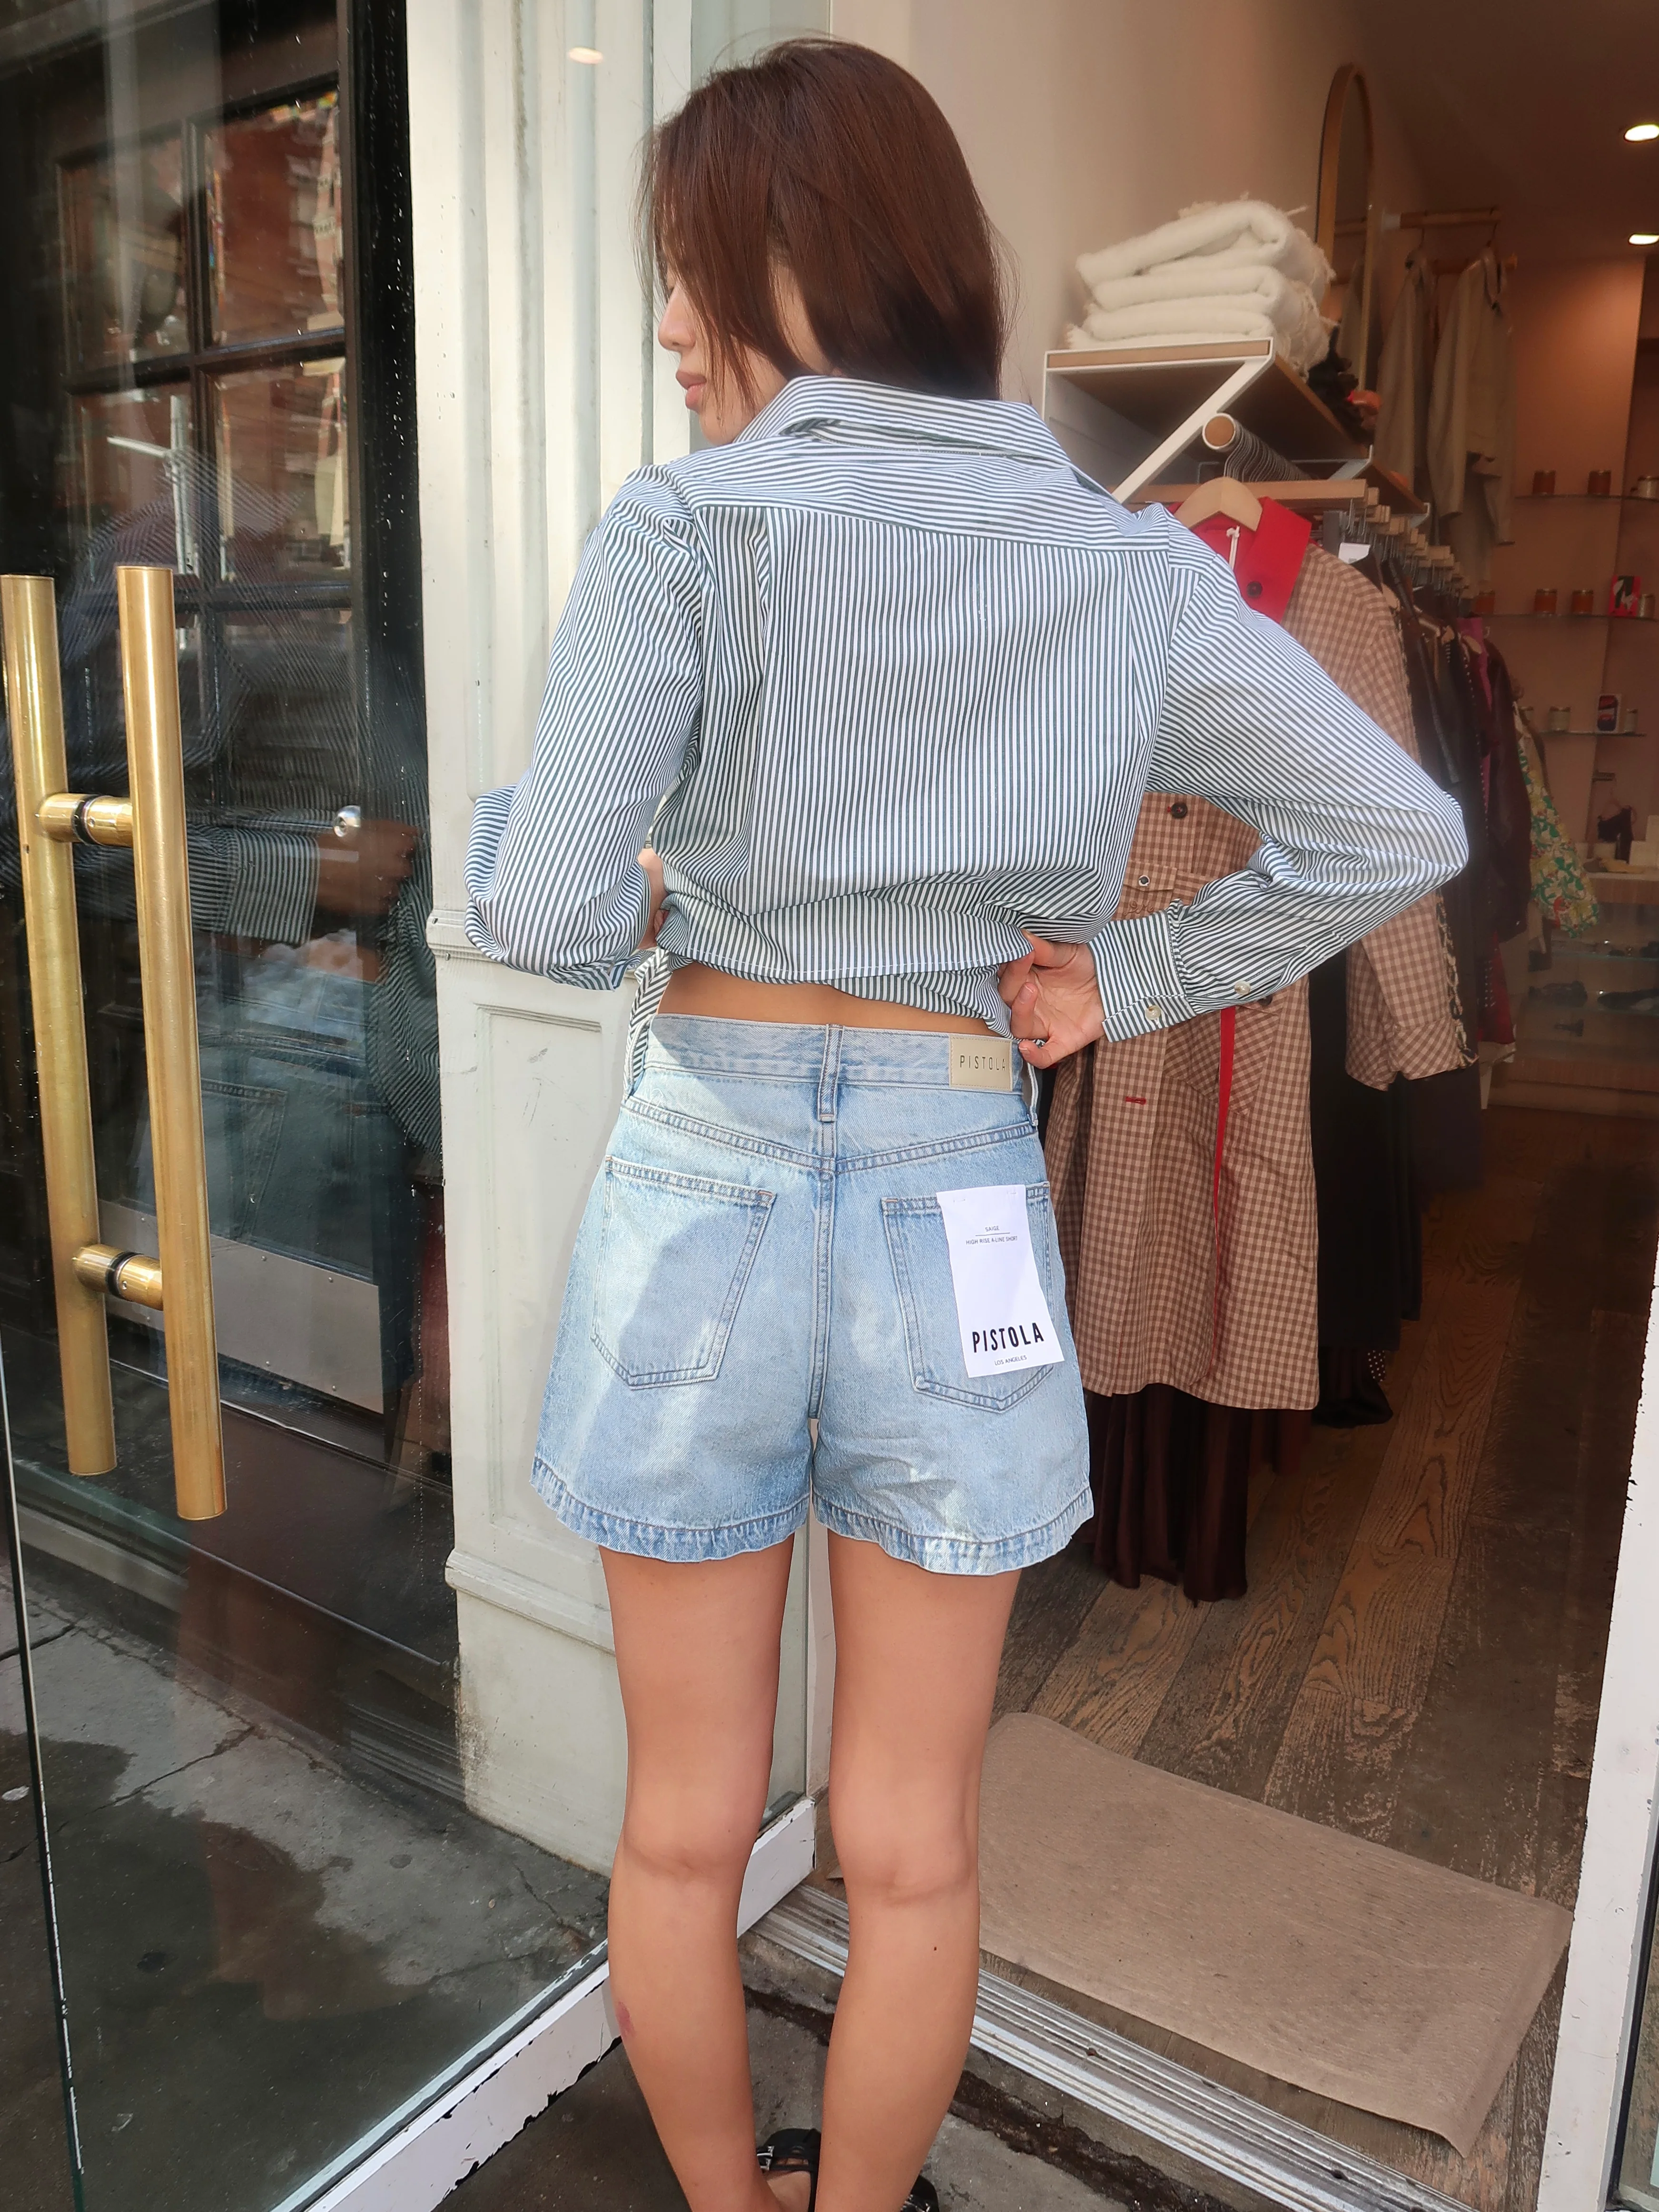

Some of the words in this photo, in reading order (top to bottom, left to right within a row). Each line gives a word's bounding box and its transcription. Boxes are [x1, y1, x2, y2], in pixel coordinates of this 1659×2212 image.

[960, 1055, 1006, 1071] PISTOLA
[972, 1323, 1044, 1353] PISTOLA
[1005, 1355, 1027, 1363] ANGELES
